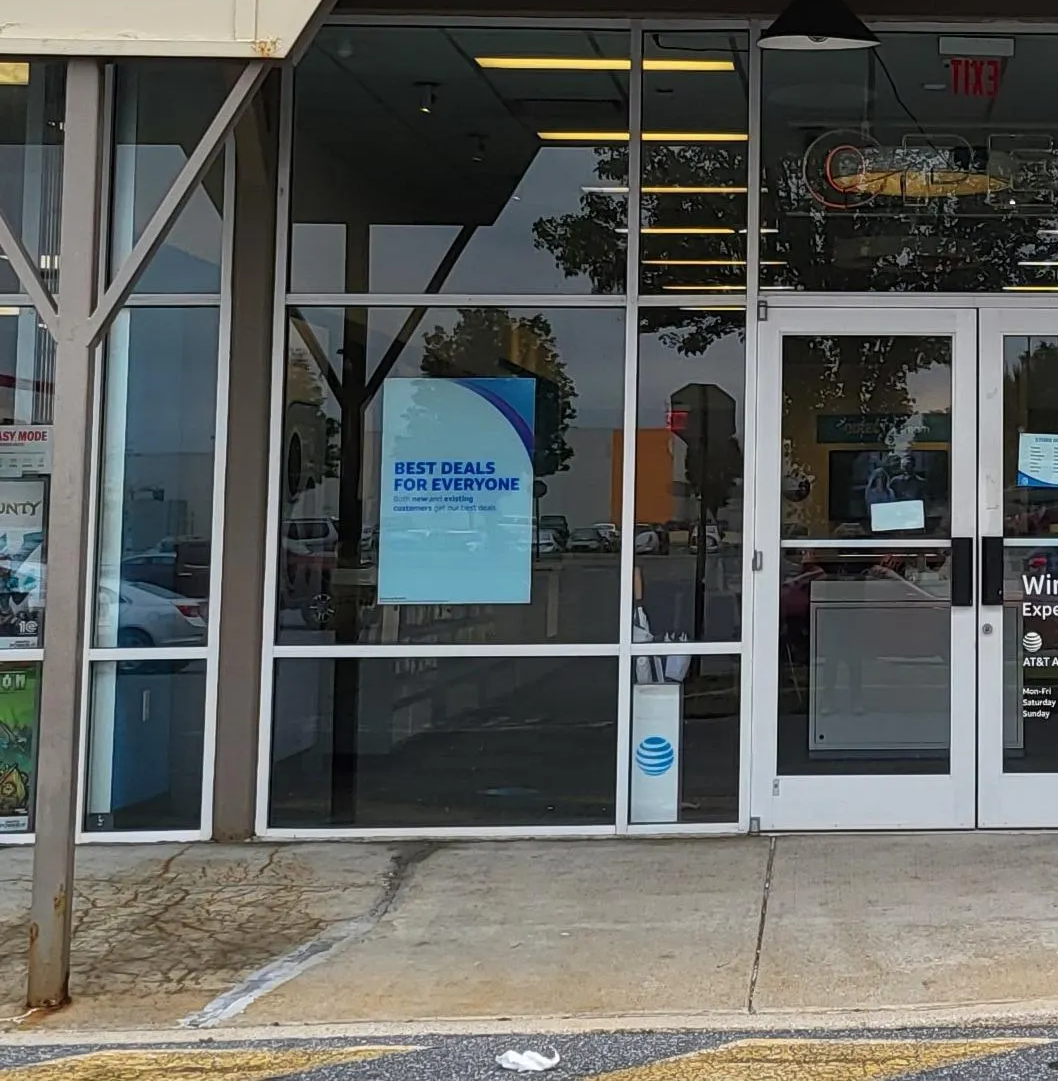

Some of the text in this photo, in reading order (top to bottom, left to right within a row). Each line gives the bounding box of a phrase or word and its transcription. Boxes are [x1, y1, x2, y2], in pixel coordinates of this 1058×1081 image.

[19, 430, 48, 442] MODE
[394, 461, 496, 475] BEST DEALS
[394, 477, 520, 491] FOR EVERYONE
[443, 495, 474, 504] existing
[1022, 657, 1050, 667] AT&T
[1022, 687, 1052, 695] Mon-Fri
[1022, 698, 1057, 707] Saturday
[1022, 710, 1050, 719] Sunday
